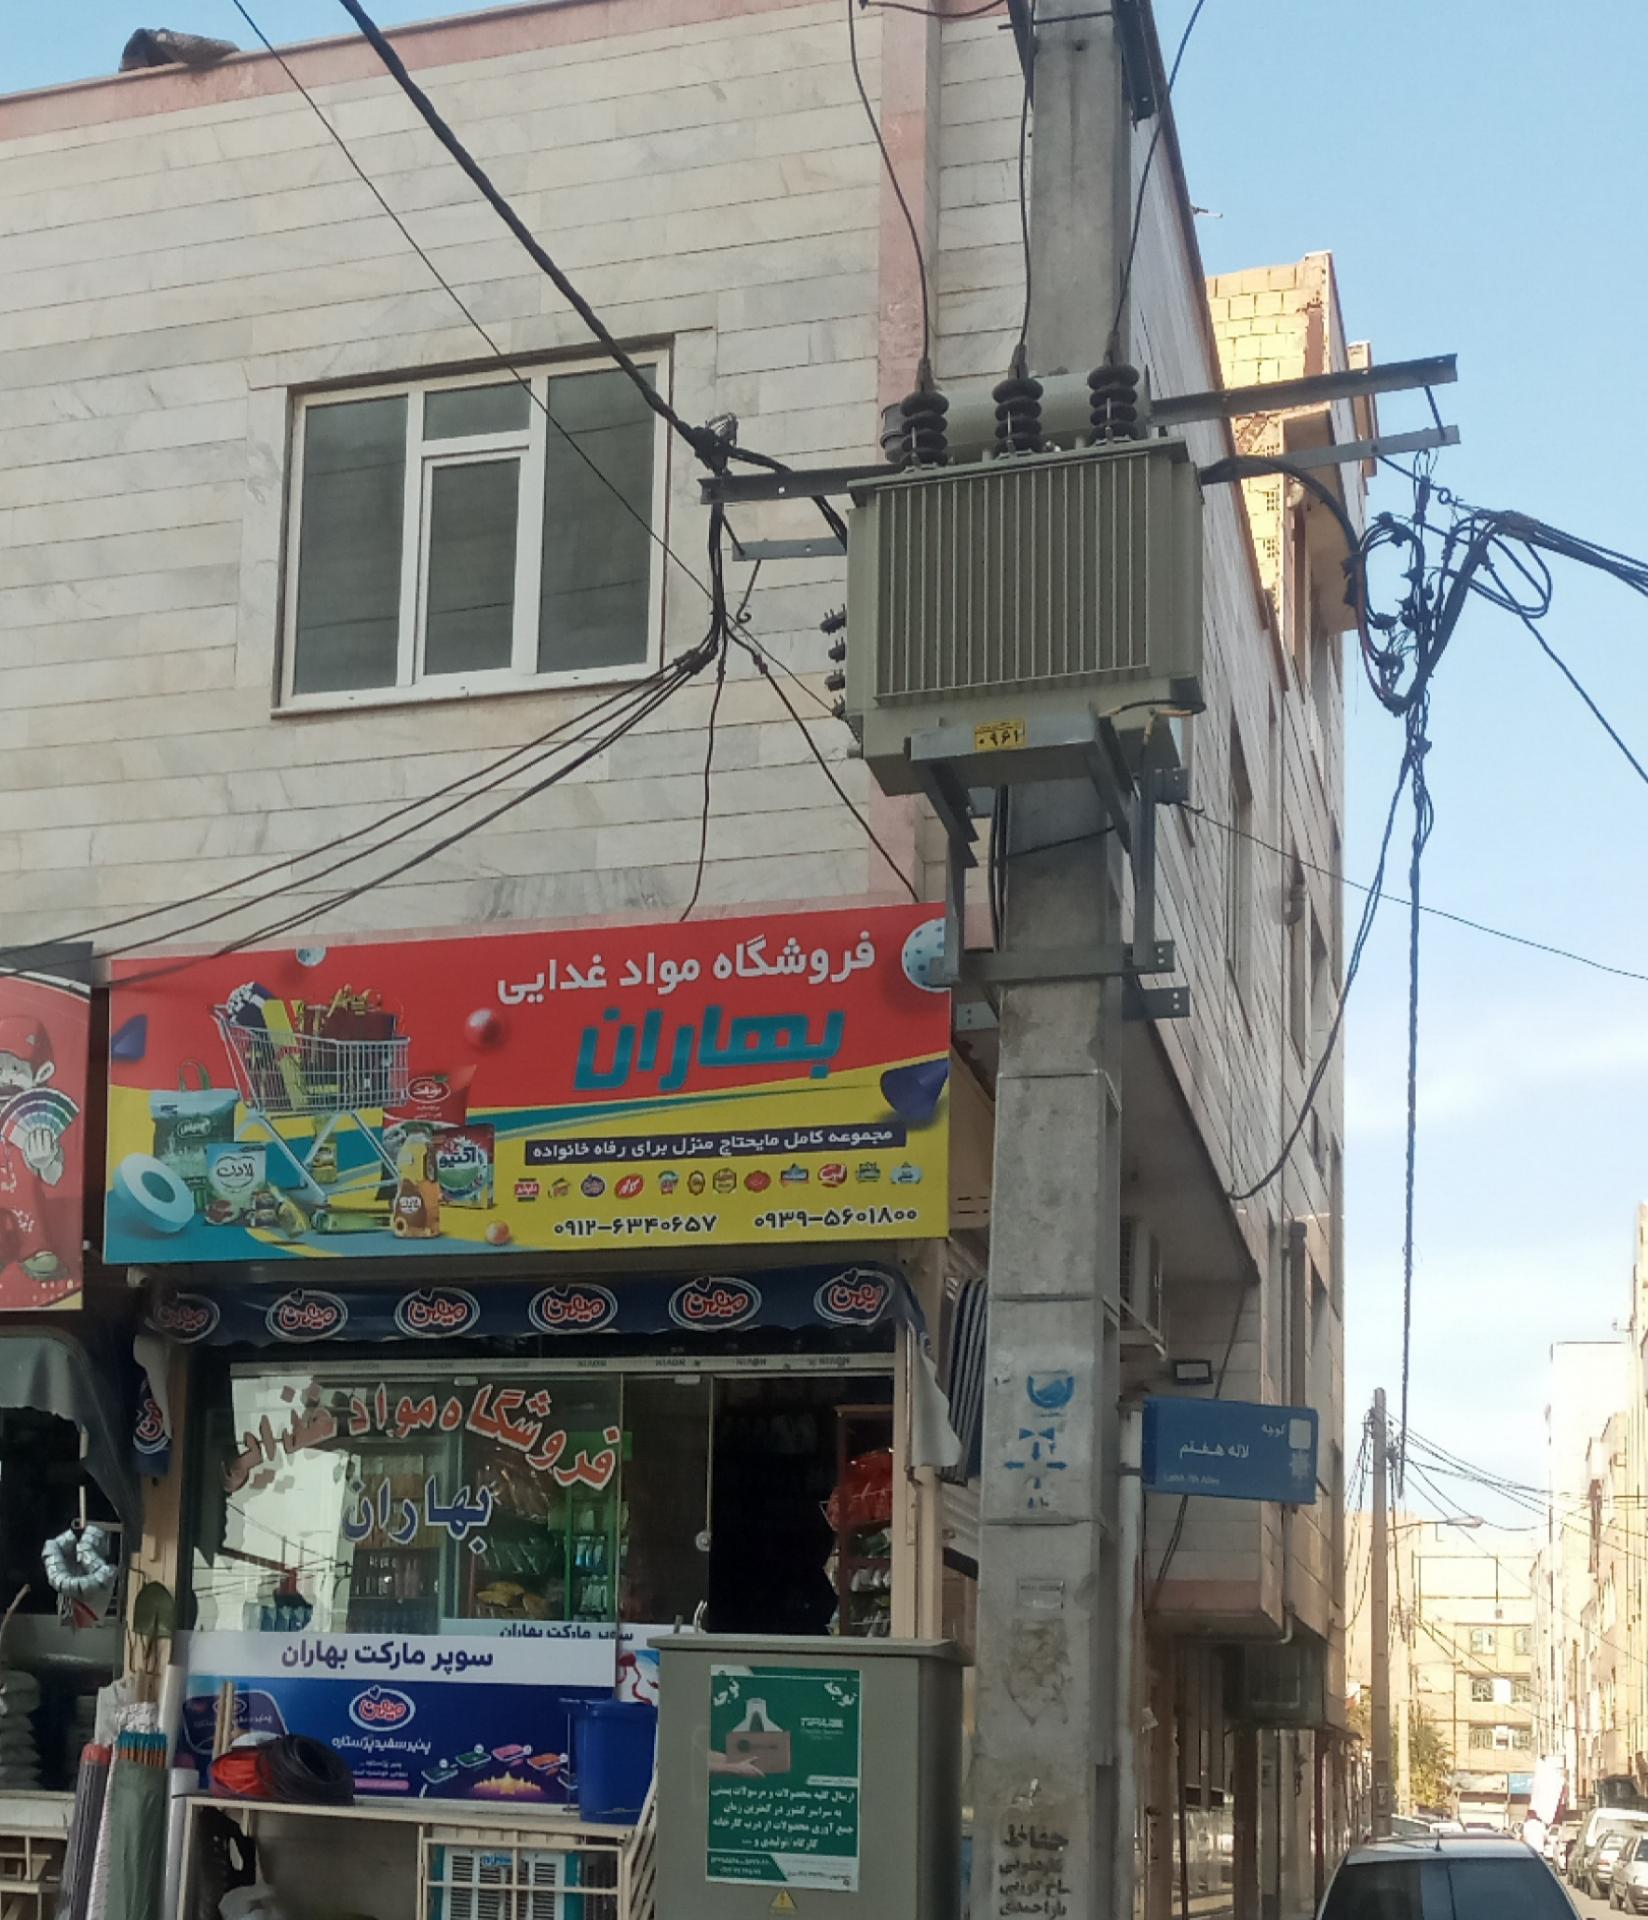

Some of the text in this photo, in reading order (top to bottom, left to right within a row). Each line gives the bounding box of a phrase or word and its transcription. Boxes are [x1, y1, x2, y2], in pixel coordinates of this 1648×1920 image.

[712, 931, 876, 983] فروشگاه
[620, 952, 700, 995] مواد
[573, 1004, 846, 1091] بهاران
[532, 1130, 894, 1161] مجموعه کامل مایحتاج منزل برای رفاه خانواده
[278, 1303, 337, 1330] میهن
[408, 1300, 468, 1328] میهن
[543, 1294, 604, 1322] میهن
[683, 1290, 748, 1318] میهن
[348, 1383, 436, 1439] مواد
[440, 1384, 620, 1491] فروشگاه
[1261, 1423, 1286, 1438] کوچه
[1228, 1444, 1250, 1458] لاله
[343, 1475, 493, 1555] بهاران
[281, 1638, 494, 1674] سوپر مارکت بهاران
[357, 1697, 406, 1720] میهن
